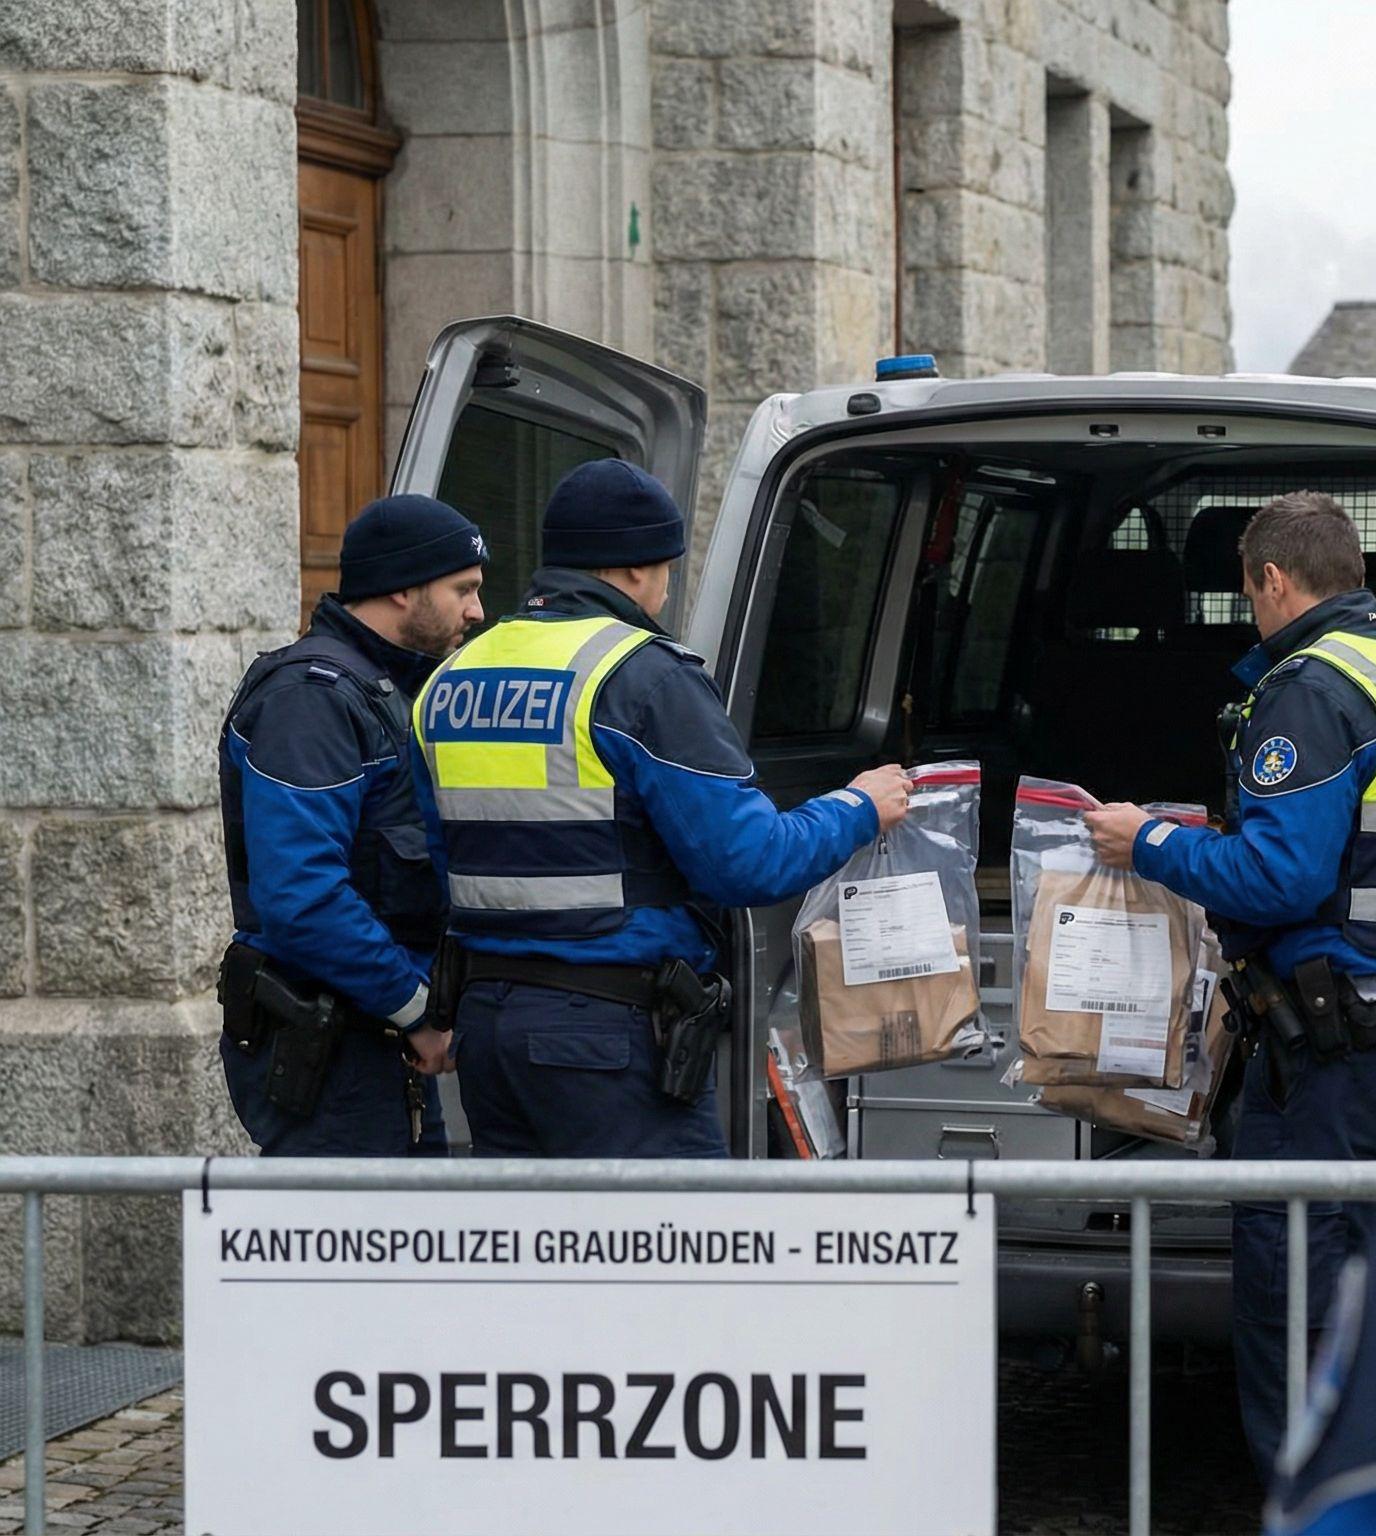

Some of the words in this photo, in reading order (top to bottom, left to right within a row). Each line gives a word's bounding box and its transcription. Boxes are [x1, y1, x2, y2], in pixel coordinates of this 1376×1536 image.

[428, 680, 564, 729] POLIZEI
[221, 1228, 520, 1264] KANTONSPOLIZEI
[534, 1222, 775, 1264] GRAUBÜNDEN
[816, 1231, 959, 1264] EINSATZ
[313, 1370, 867, 1460] SPERRZONE
